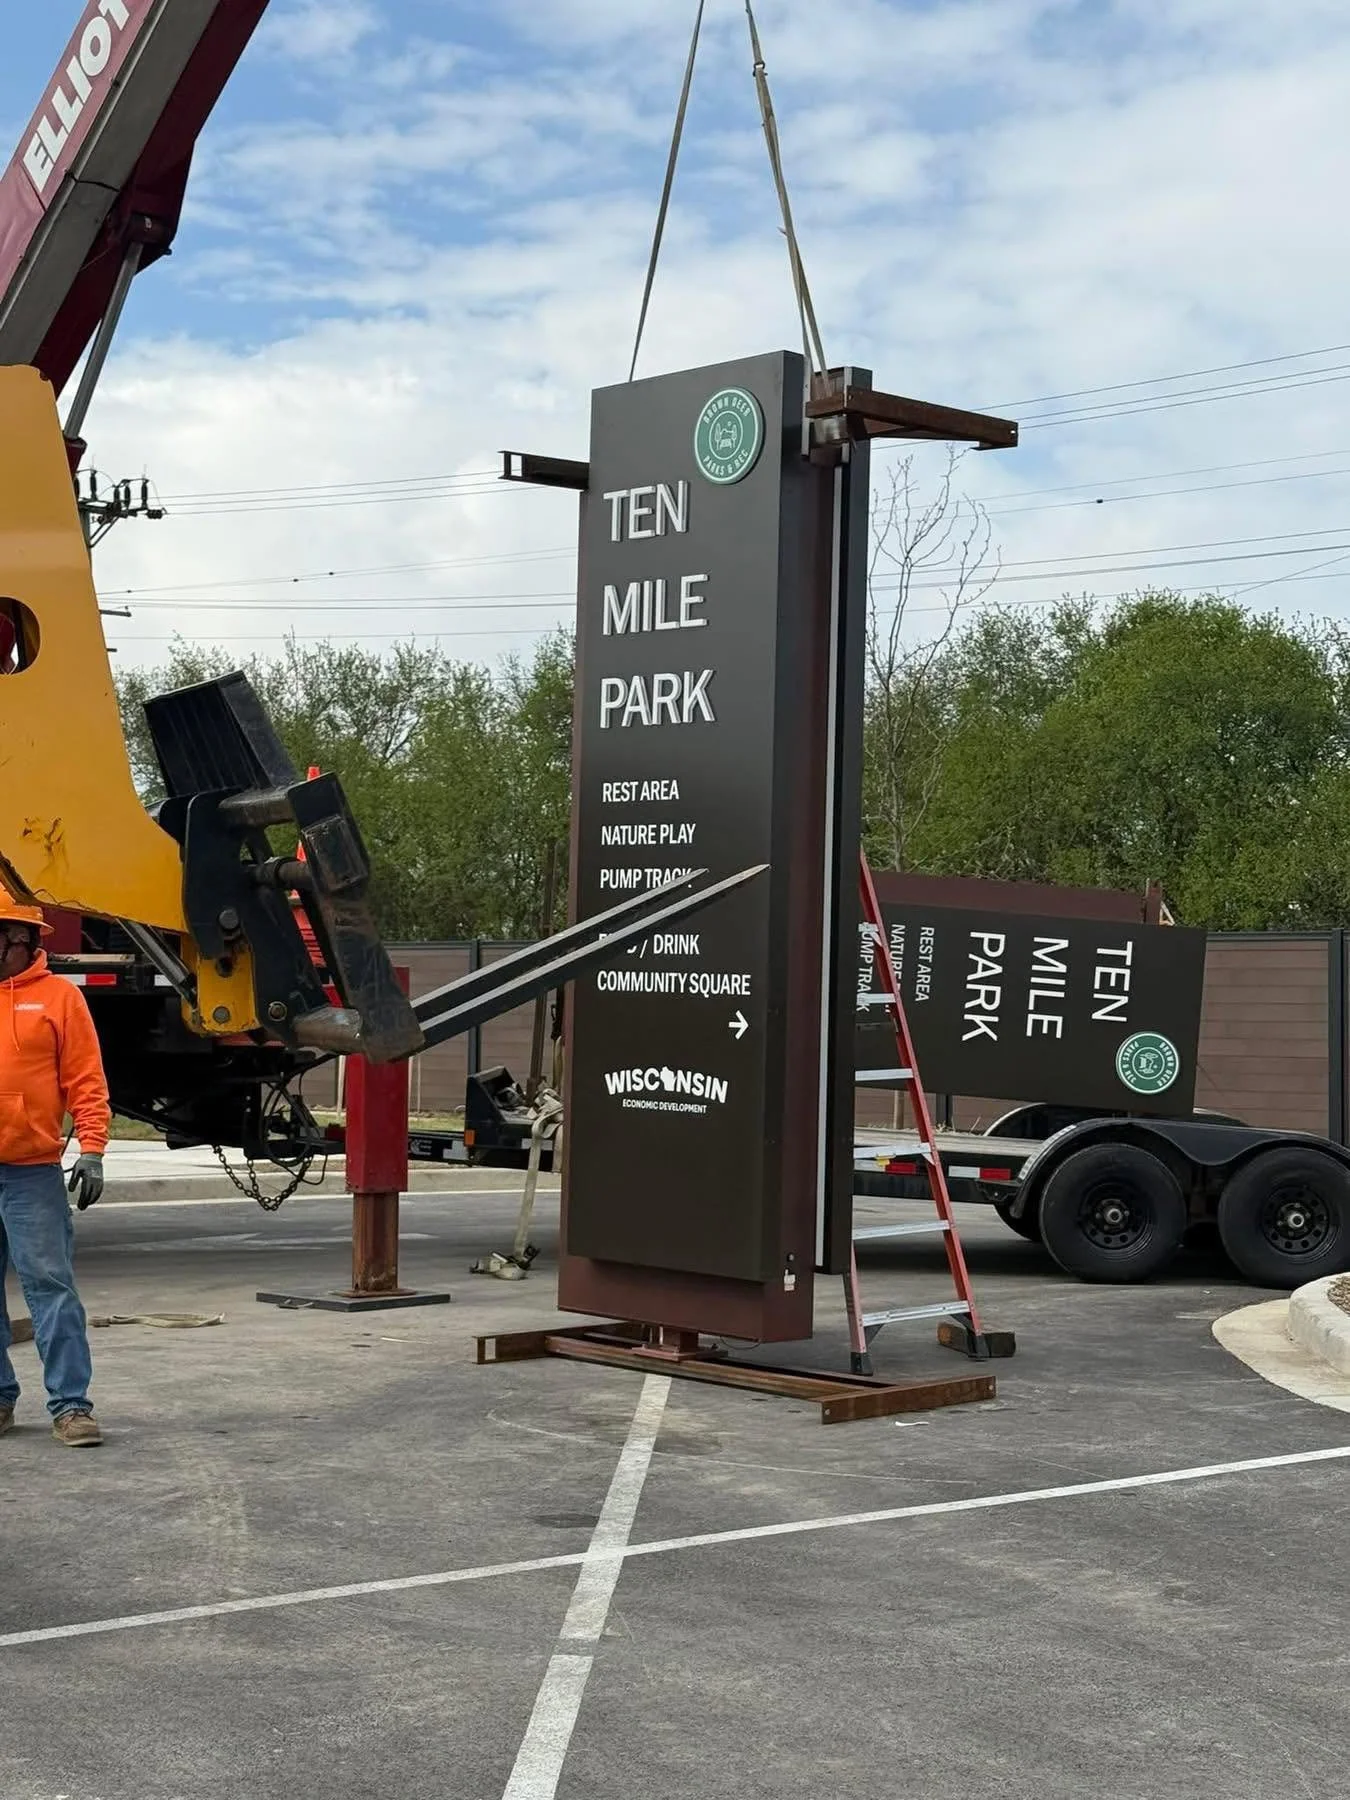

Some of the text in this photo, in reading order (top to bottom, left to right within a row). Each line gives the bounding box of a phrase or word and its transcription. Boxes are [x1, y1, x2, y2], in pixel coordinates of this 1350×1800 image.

[603, 480, 689, 542] TEN
[602, 574, 710, 636] MILE
[599, 669, 716, 729] PARK
[602, 779, 680, 803] REST AREA
[601, 823, 697, 846] NATURE PLAY
[600, 868, 642, 889] PUMP
[653, 933, 700, 955] DRINK
[915, 926, 935, 1002] REST AREA
[597, 970, 752, 999] COMMUNITY SQUARE
[856, 966, 873, 1012] TRAK
[961, 931, 1007, 1042] PARK
[1025, 936, 1070, 1039] MILE
[1091, 941, 1133, 1023] TEN
[622, 1098, 708, 1114] ECONOMIC DEVELOPMENT
